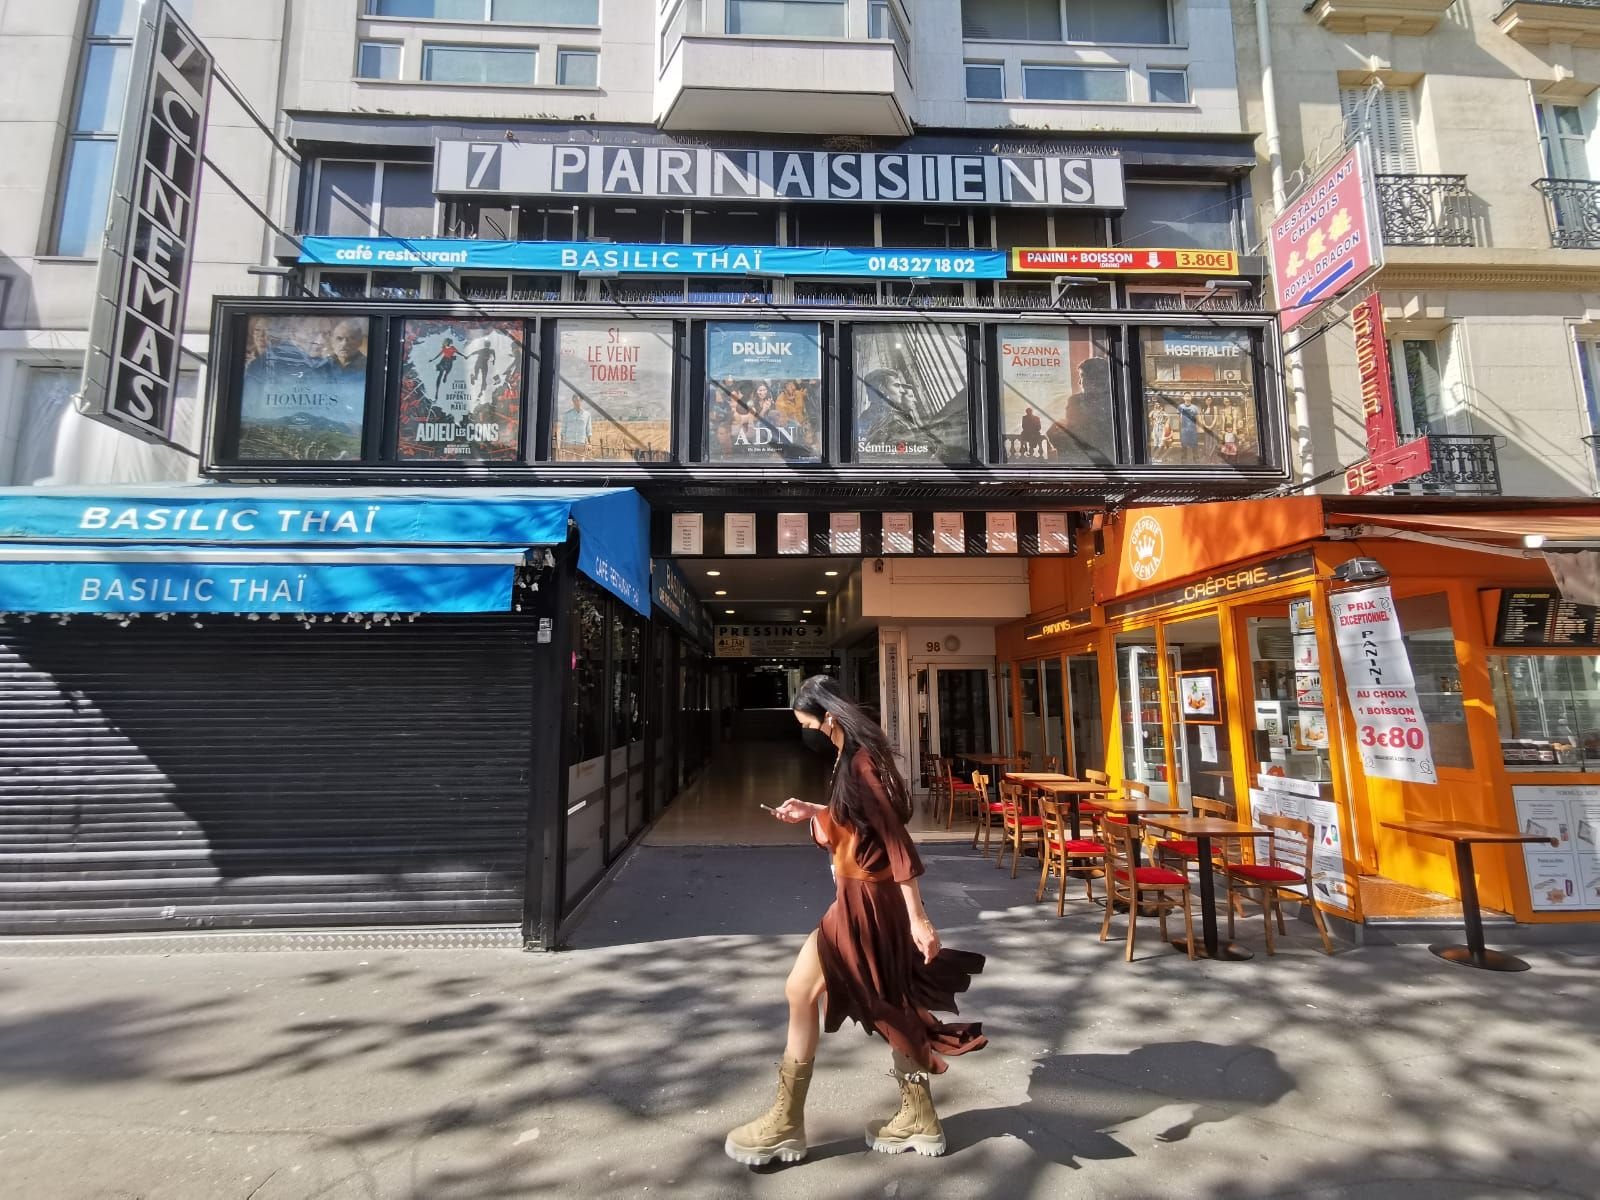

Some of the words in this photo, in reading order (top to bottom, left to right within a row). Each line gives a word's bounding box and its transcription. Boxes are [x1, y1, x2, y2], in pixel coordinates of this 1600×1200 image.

[171, 35, 196, 68] 7
[470, 145, 498, 188] 7
[554, 147, 1093, 202] PARNASSIENS
[1277, 160, 1353, 239] RESTAURANT
[1291, 194, 1338, 242] CHINOIS
[128, 90, 194, 423] CINEMAS
[336, 244, 372, 261] café
[377, 249, 468, 263] restaurant
[561, 248, 679, 268] BASILIC
[692, 249, 762, 270] THAÏ
[1027, 252, 1068, 263] PANINI
[1080, 253, 1133, 264] BOISSON
[1181, 253, 1226, 267] 3.80€
[1284, 271, 1313, 299] ROYAL
[1315, 231, 1360, 279] DRAGON
[608, 327, 620, 344] SI
[588, 346, 602, 363] LE
[606, 346, 640, 363] VENT
[732, 342, 792, 356] DRUNK
[1002, 343, 1060, 356] SUZANNA
[1011, 355, 1061, 367] ANDLER
[590, 364, 637, 382] TOMBE
[415, 423, 455, 442] ADIEU
[455, 427, 466, 437] LES
[466, 422, 500, 442] CONS
[734, 426, 796, 446] ADN
[79, 506, 259, 531] BASILIC
[278, 505, 380, 533] THAÏ
[80, 577, 214, 601] BASILIC
[228, 574, 308, 602] THAÏ
[1184, 566, 1268, 600] CRÊPERIE
[1347, 600, 1376, 612] PRIX
[1339, 611, 1390, 627] EXCEPTIONNEL
[719, 626, 808, 637] PRESSING
[926, 641, 941, 652] 98
[1361, 630, 1383, 685] PANINI
[1357, 690, 1370, 698] AU
[1373, 690, 1407, 698] CHOIX
[1358, 707, 1364, 715] 1
[1367, 707, 1415, 715] BOISSON
[1361, 725, 1424, 750] 3€80
